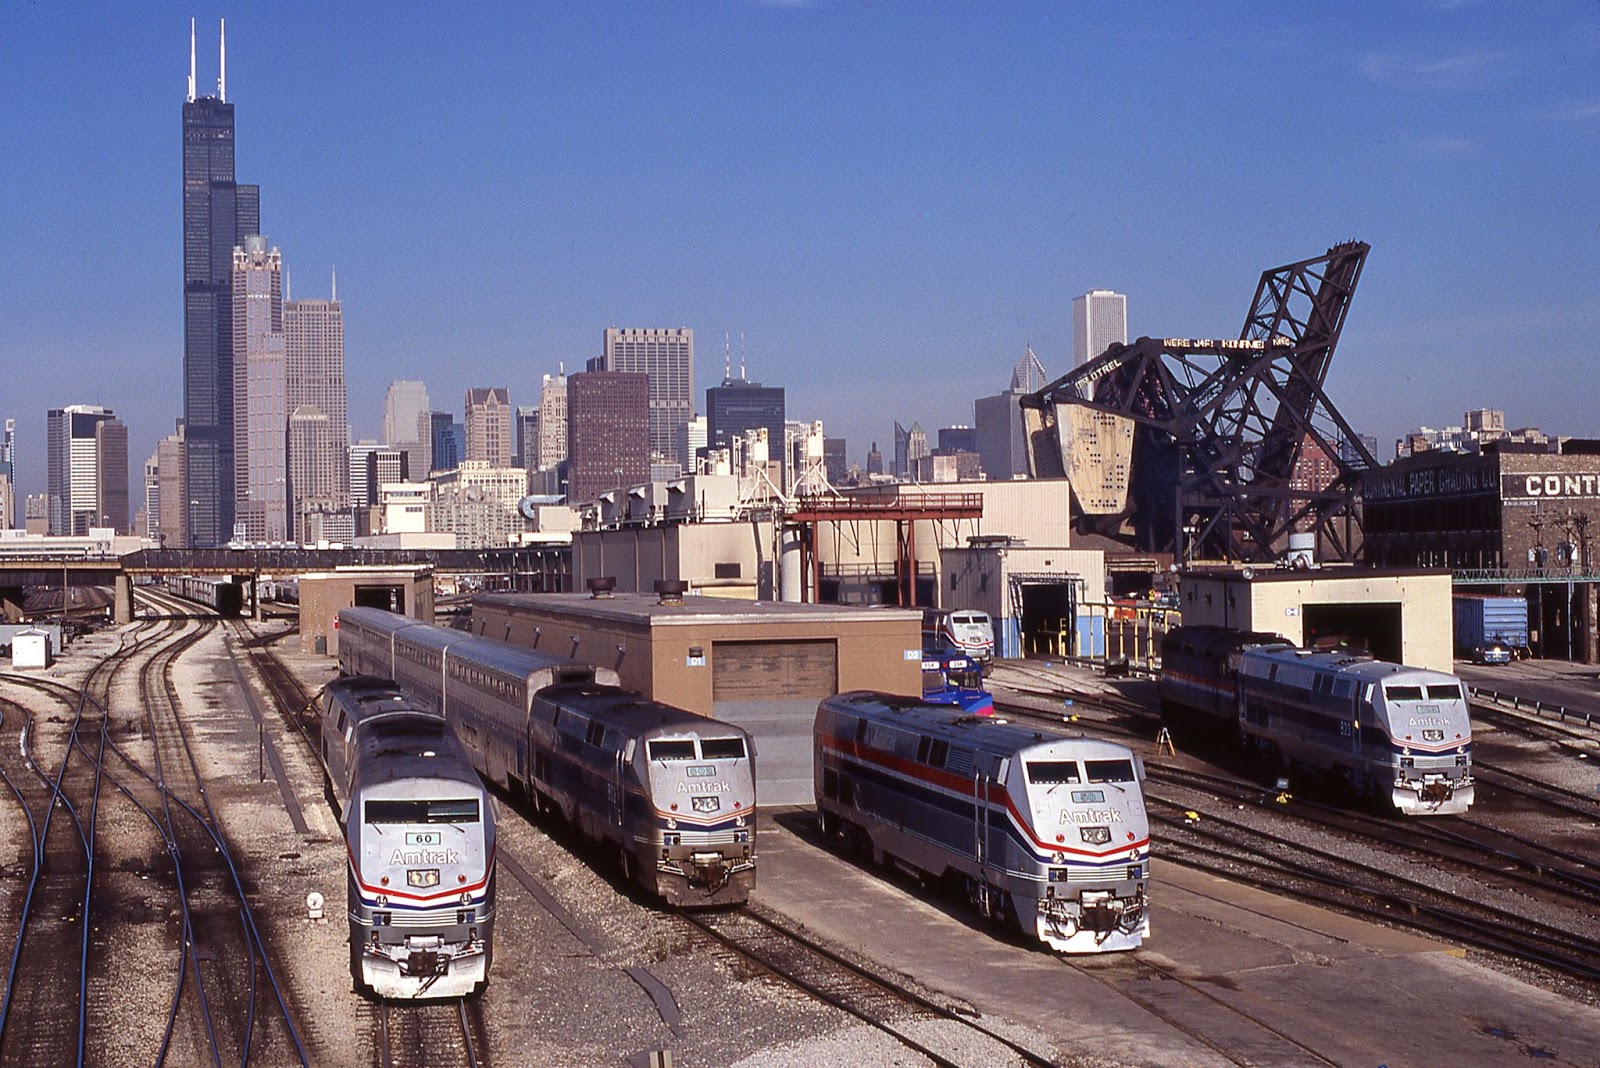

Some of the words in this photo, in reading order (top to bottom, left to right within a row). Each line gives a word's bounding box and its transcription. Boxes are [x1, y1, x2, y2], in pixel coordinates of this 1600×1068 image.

[1410, 470, 1435, 496] PAPER
[691, 656, 702, 666] D1
[907, 651, 919, 660] D2
[1409, 716, 1452, 726] Amtrak
[676, 780, 731, 794] Amtrak
[1059, 807, 1123, 825] Amtrak
[416, 834, 432, 844] 60
[390, 848, 459, 865] Amtrak
